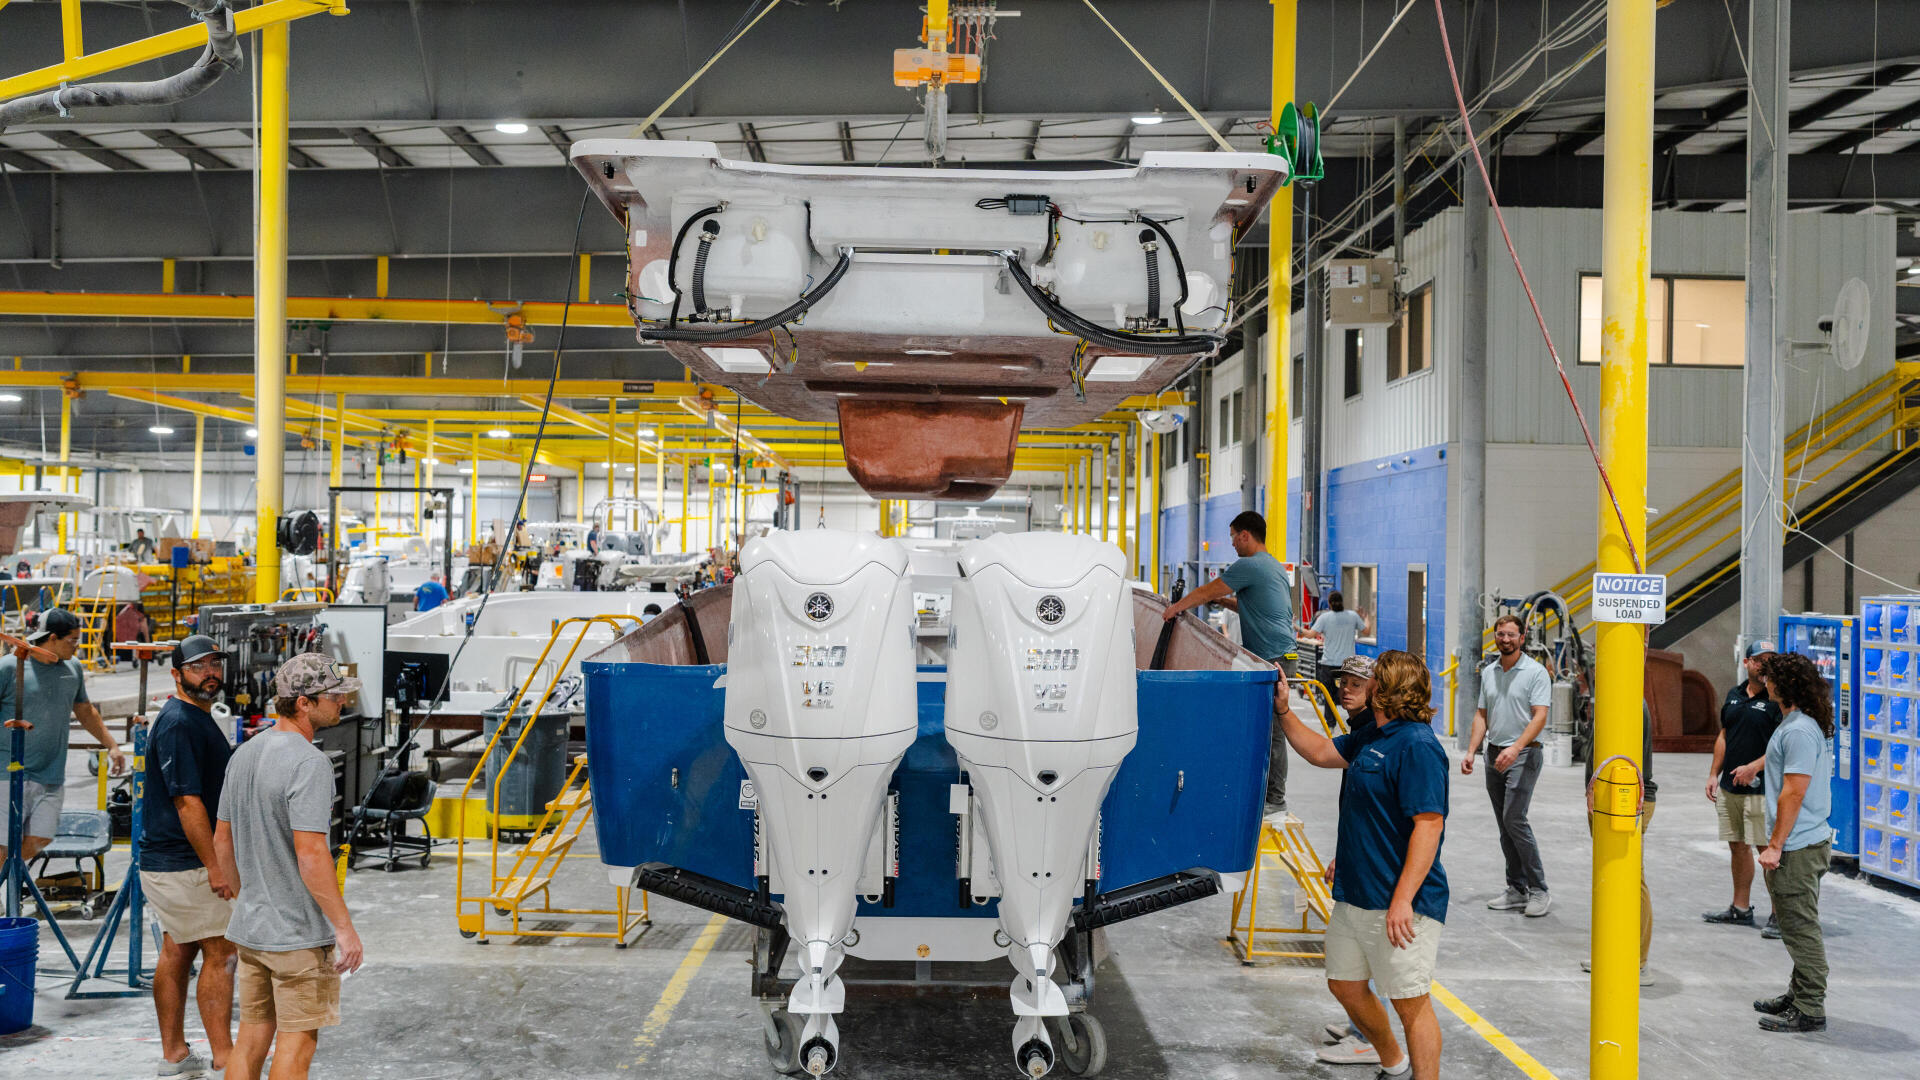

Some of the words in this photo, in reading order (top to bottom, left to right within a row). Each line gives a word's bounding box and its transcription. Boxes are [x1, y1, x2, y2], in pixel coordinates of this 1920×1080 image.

[1599, 578, 1661, 593] NOTICE
[1598, 598, 1660, 609] SUSPENDED
[1616, 609, 1642, 619] LOAD
